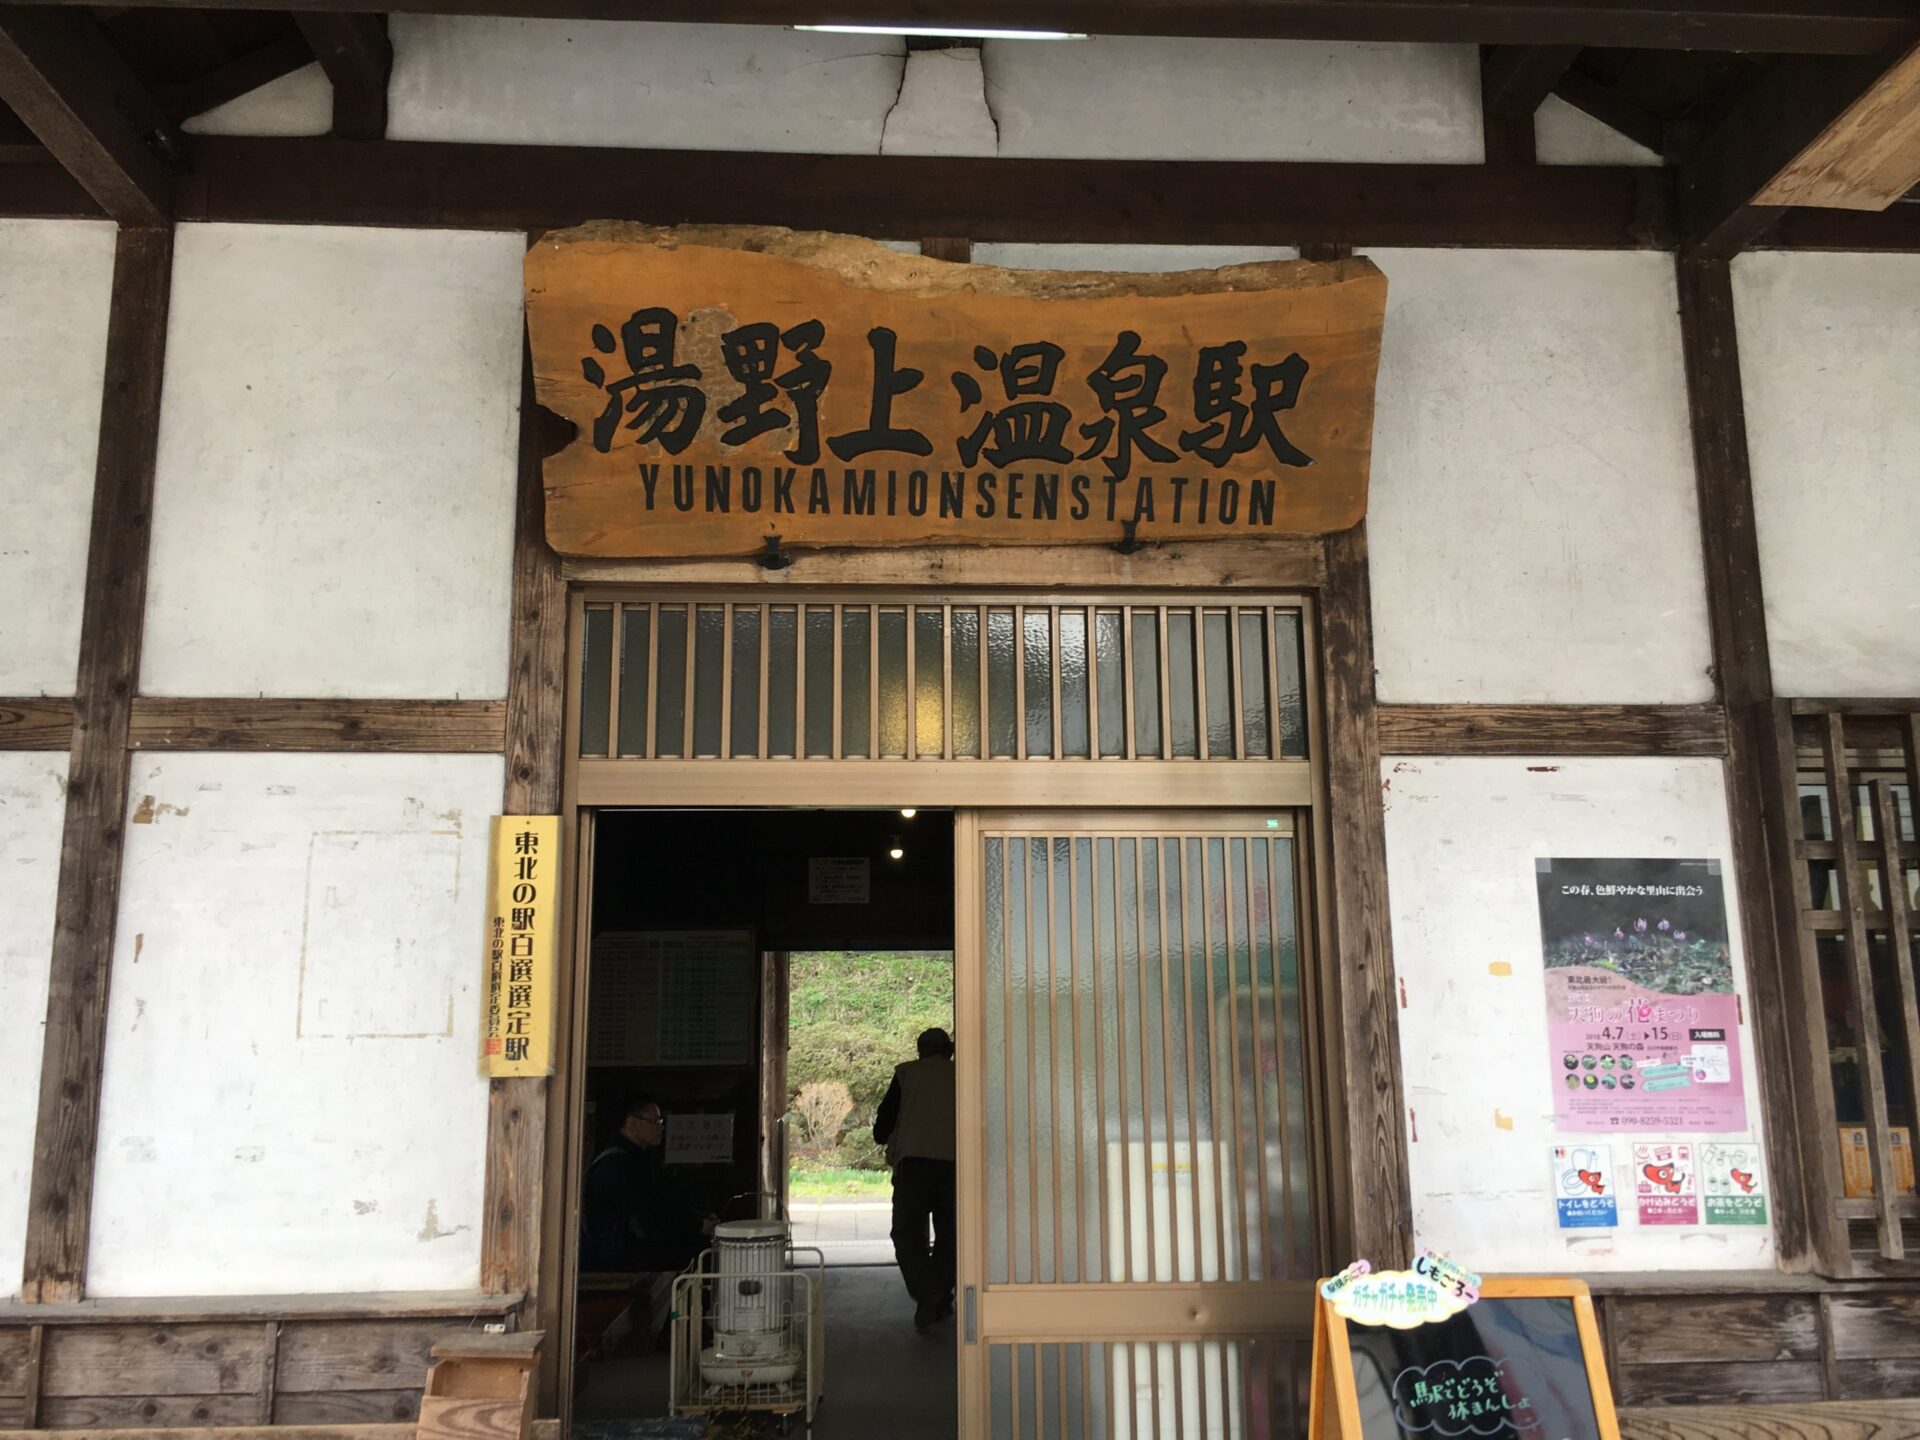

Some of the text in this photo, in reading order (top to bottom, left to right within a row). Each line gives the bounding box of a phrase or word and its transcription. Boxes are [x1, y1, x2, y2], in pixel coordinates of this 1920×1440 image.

[581, 307, 1316, 479] 湯野上温泉駅
[639, 463, 1276, 527] YUNOKAMIONSENSTATION
[1561, 884, 1703, 896] この春、色鮮やかな里山に出会う
[504, 830, 539, 1062] 東北の駅百選選定駅
[1567, 997, 1700, 1024] 天狗の花まつり
[1558, 1198, 1616, 1210] トイレをどうぞ
[1638, 1197, 1696, 1208] かけ込みどうぞ
[1706, 1197, 1763, 1209] お茶をどうぞ
[1416, 1256, 1475, 1300] しもごろー
[1409, 1370, 1504, 1408] 駅でどうぞ
